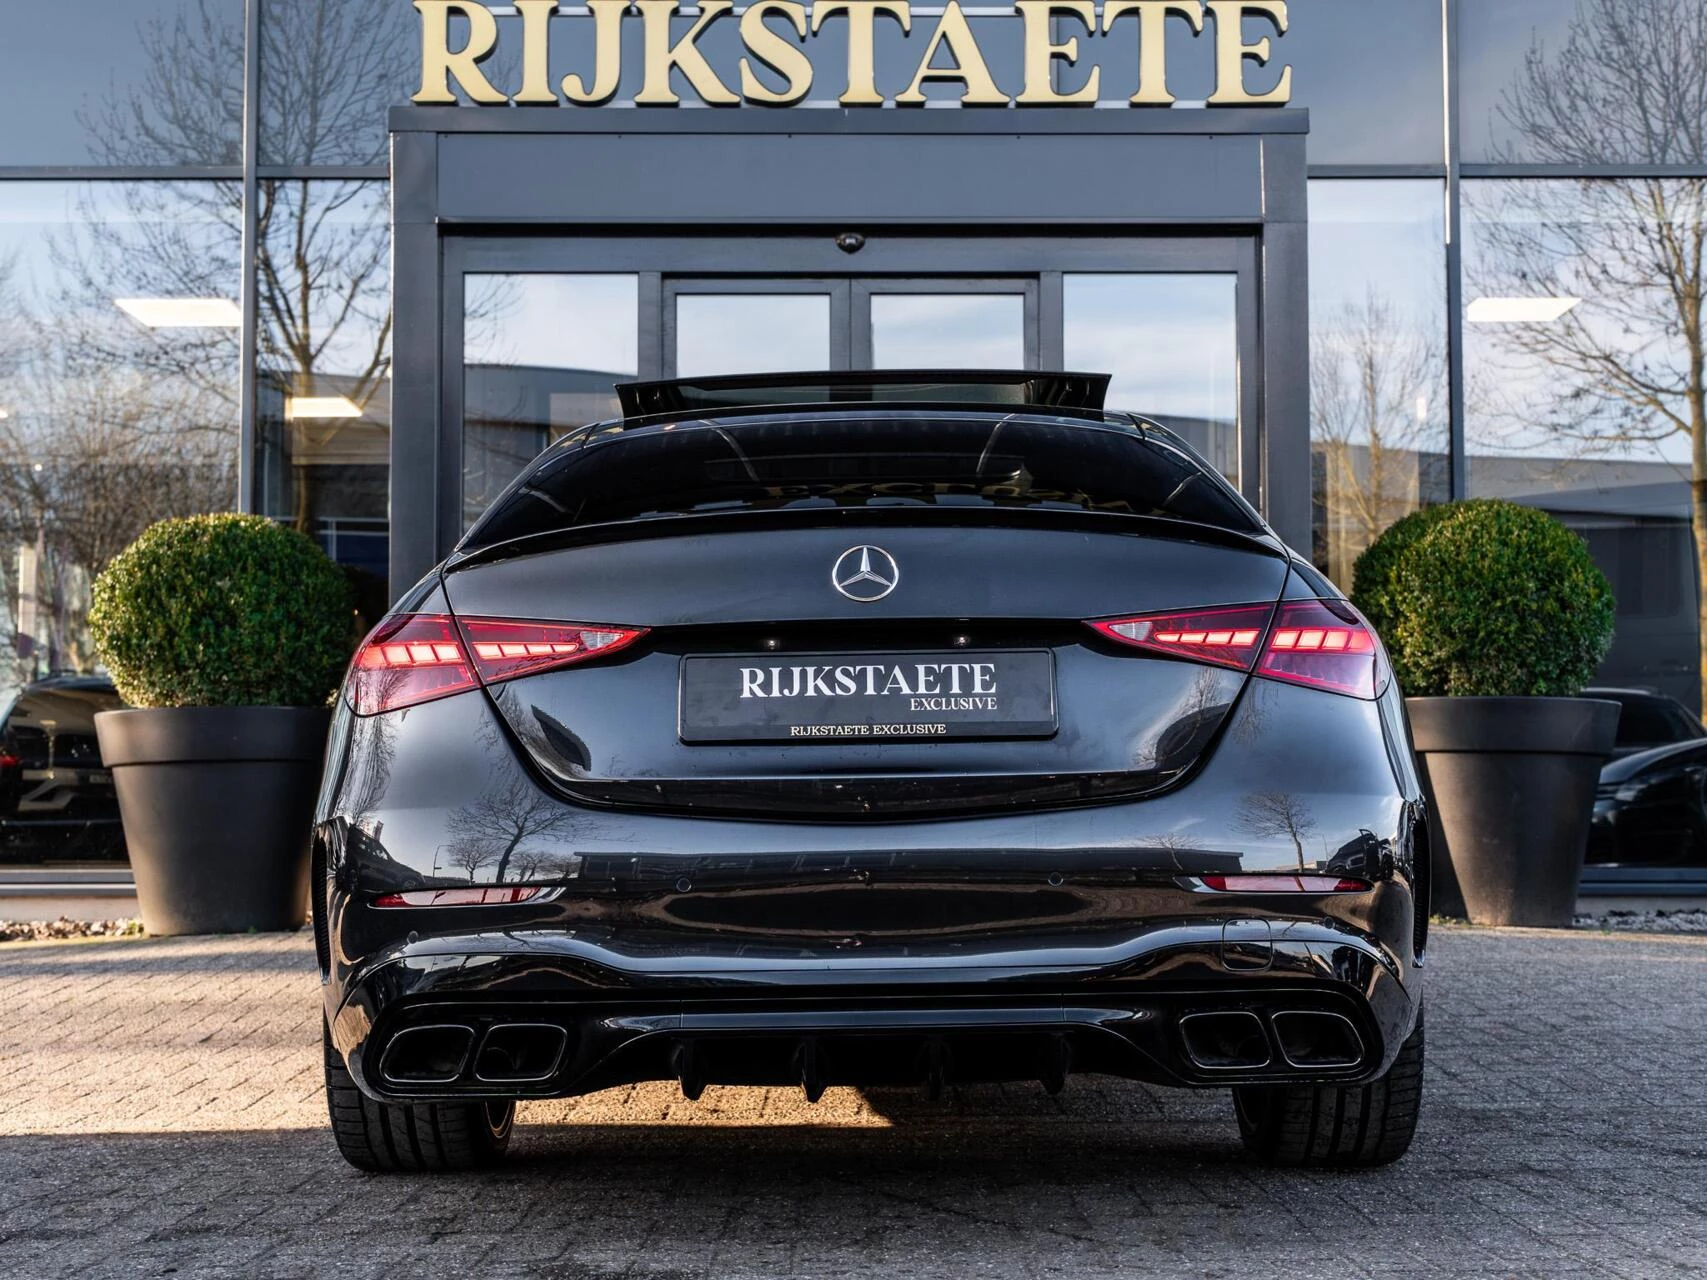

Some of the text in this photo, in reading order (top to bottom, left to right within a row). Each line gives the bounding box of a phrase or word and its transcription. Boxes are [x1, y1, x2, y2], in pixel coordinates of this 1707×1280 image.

[411, 0, 1292, 105] RIJKSTAETE
[739, 663, 997, 698] RIJKSTAETE
[910, 697, 998, 711] EXCLUSIVE
[790, 723, 947, 737] RIJKSTAETE EXCLUSIVE
